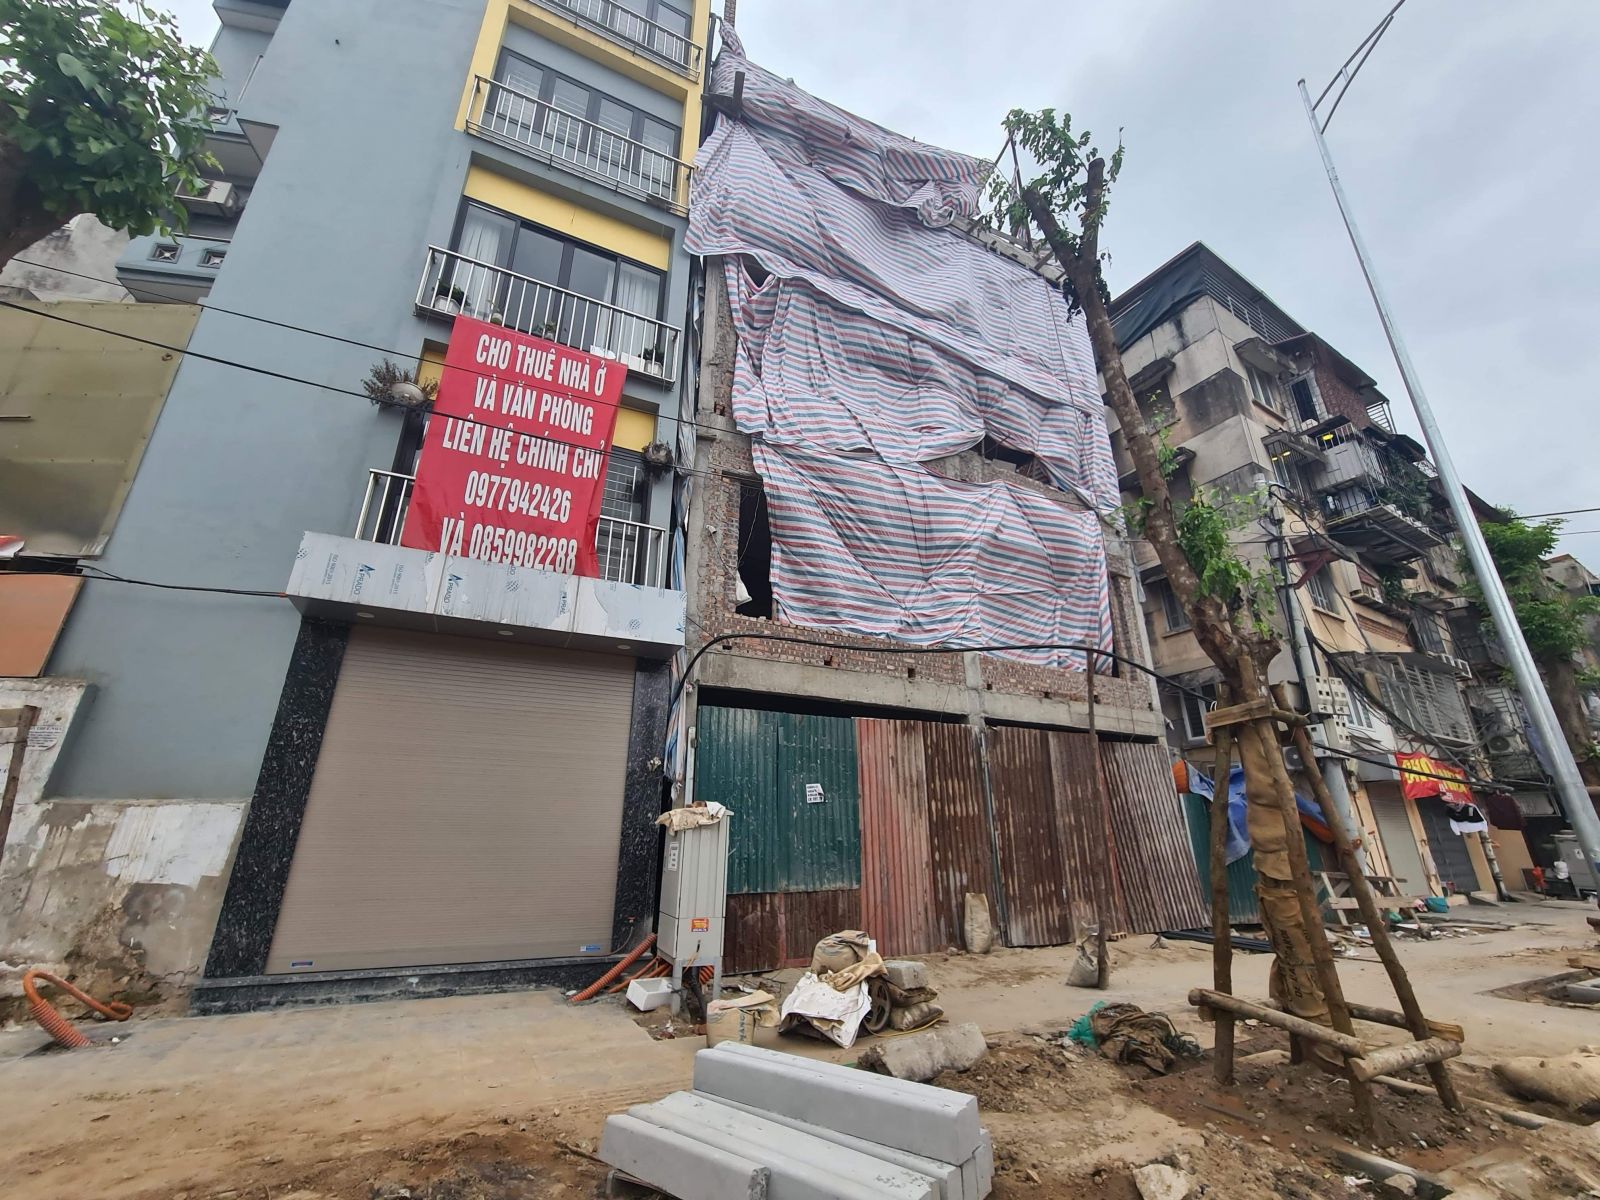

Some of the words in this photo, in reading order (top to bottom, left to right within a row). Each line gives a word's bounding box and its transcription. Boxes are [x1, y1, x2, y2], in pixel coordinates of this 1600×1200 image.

[476, 334, 512, 371] CHO
[515, 344, 556, 382] THUÊ
[558, 357, 591, 393] NHÀ
[594, 359, 607, 397] Ở
[474, 373, 497, 412] VÀ
[501, 380, 537, 420] VĂN
[538, 392, 594, 436] PHÒNG
[442, 413, 486, 456] LIÊN
[488, 422, 514, 469] HỆ
[516, 431, 569, 474] CHÍNH
[572, 439, 605, 480] CHỦ
[464, 470, 572, 524] 0977942426
[440, 511, 465, 557] VÀ
[469, 523, 578, 575] 0859982288
[353, 572, 366, 596] PRADO
